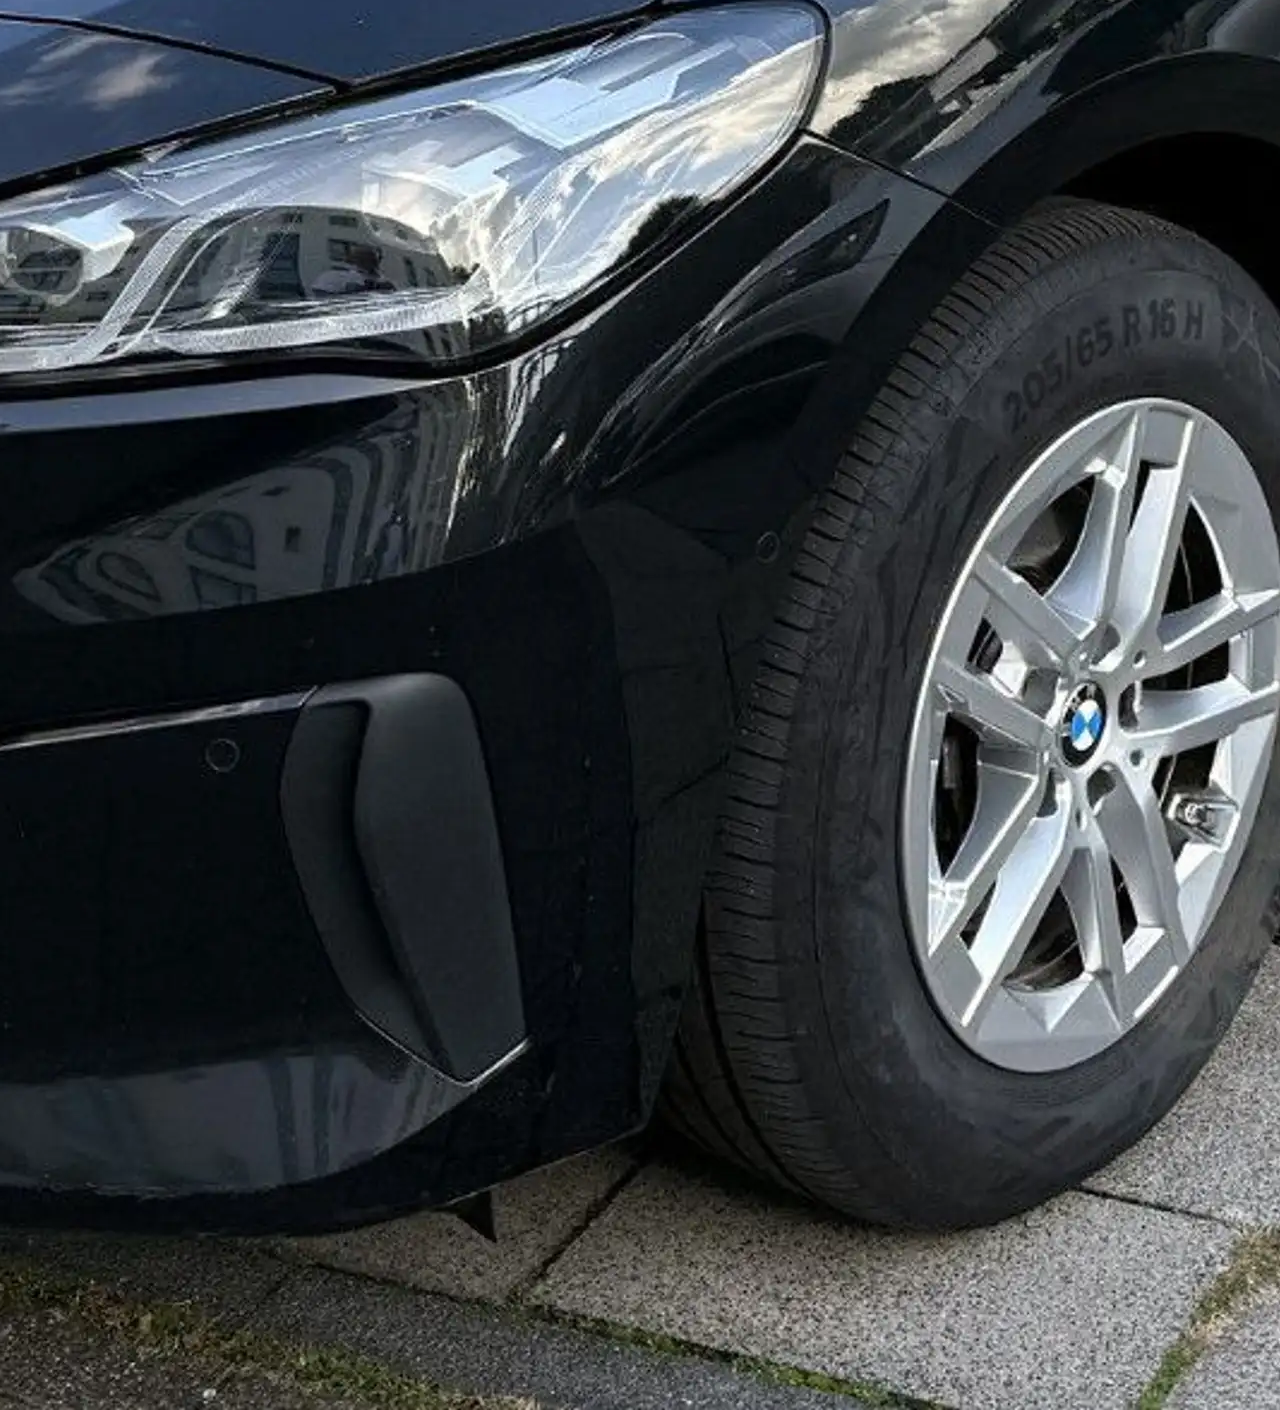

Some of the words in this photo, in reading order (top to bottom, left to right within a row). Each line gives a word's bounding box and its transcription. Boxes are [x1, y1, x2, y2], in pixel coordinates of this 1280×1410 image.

[1002, 316, 1113, 434] 205/65
[1122, 304, 1142, 348] R
[1148, 298, 1176, 339] 16
[1183, 300, 1204, 340] H
